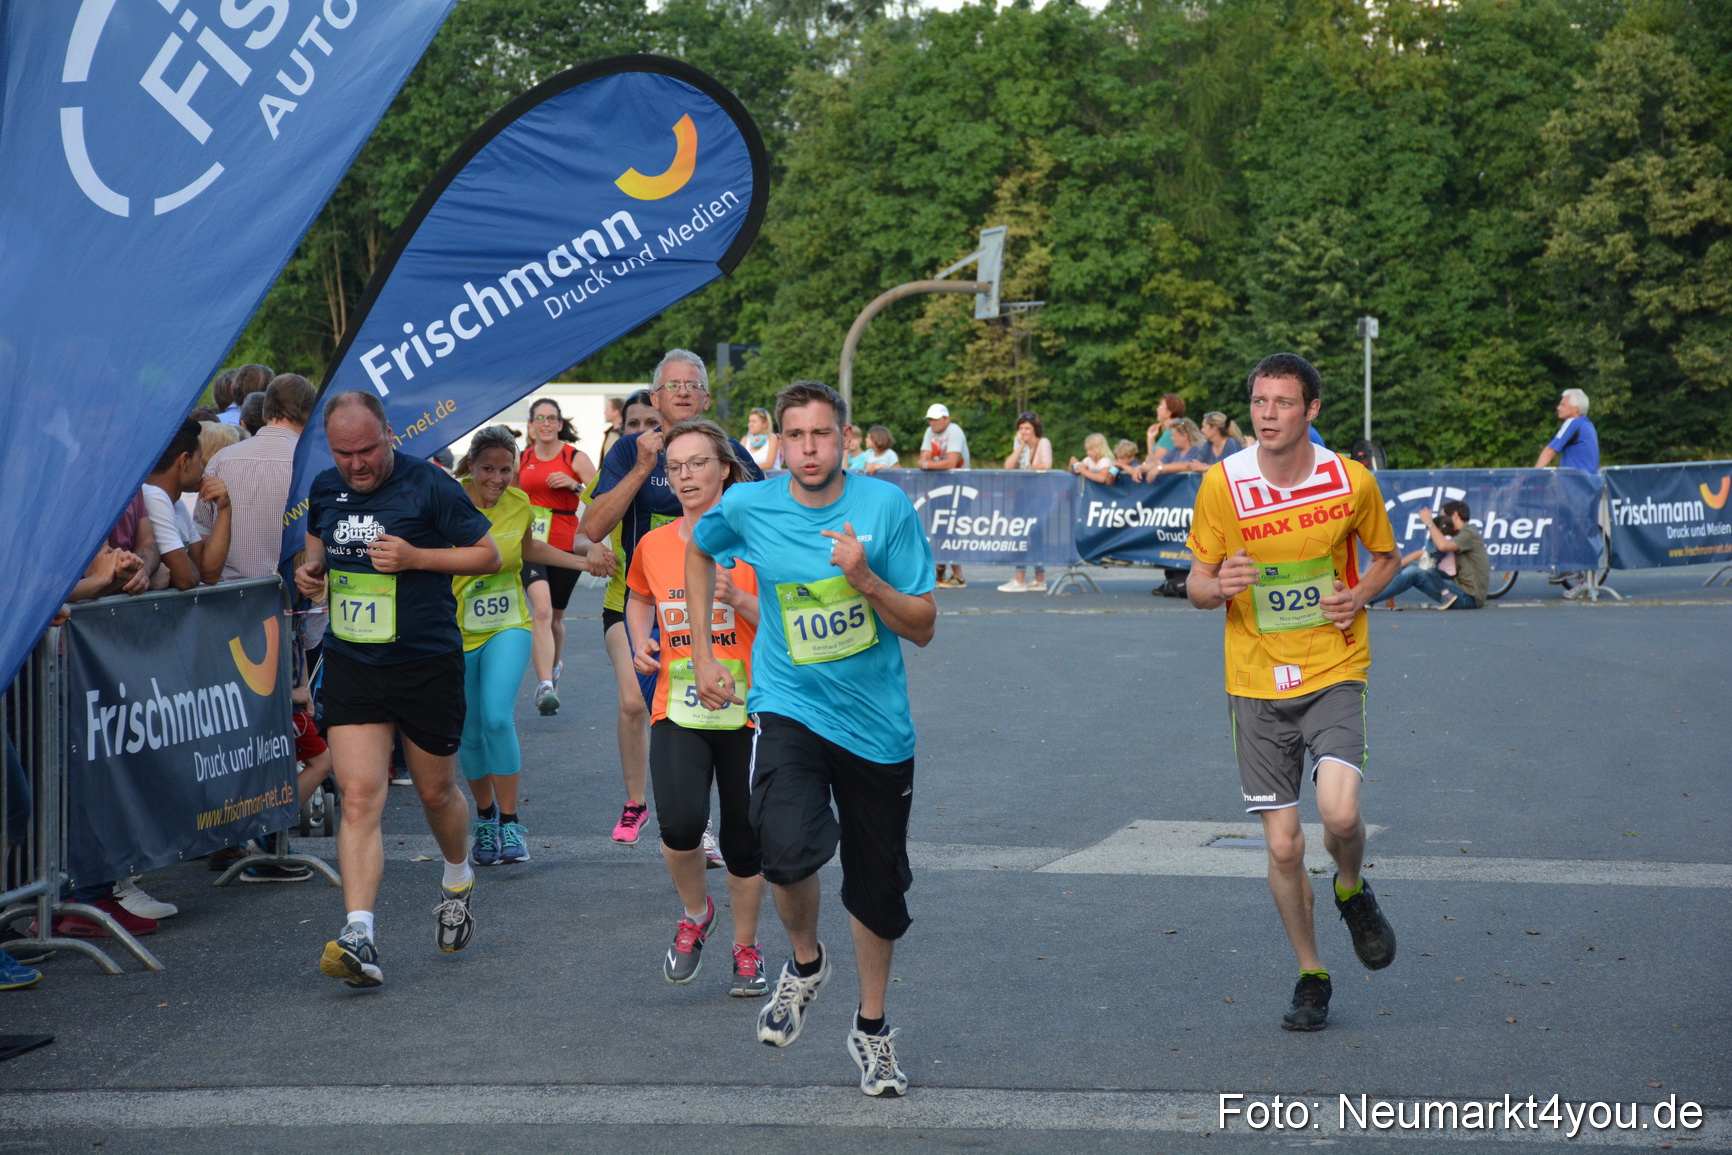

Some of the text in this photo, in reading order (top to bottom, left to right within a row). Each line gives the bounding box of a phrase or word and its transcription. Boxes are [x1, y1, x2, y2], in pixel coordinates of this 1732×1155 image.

[139, 0, 290, 145] Fis
[258, 0, 358, 140] AUTO
[543, 189, 740, 320] Druck und Medien
[359, 209, 642, 397] Frischmann
[651, 476, 670, 487] EUR
[931, 509, 1037, 536] Fischer
[1086, 501, 1194, 528] Frischman
[1241, 503, 1355, 542] MAX BÖGL
[1611, 496, 1705, 526] Frischmann
[334, 521, 385, 544] Burgis
[1405, 511, 1553, 540] Fcher
[1667, 525, 1690, 539] Druck
[1690, 523, 1706, 537] und
[940, 539, 1028, 552] AUTOMOBILE
[1484, 543, 1540, 556] OBILE
[340, 599, 376, 624] 171
[473, 595, 510, 618] 659
[1268, 586, 1321, 612] 929
[793, 603, 865, 641] 1065
[669, 631, 737, 648] eurkt
[812, 644, 838, 652] Bernhard
[86, 677, 249, 761] Frischmann
[193, 745, 229, 782] Druck
[230, 737, 253, 770] und
[1243, 793, 1276, 802] hummel
